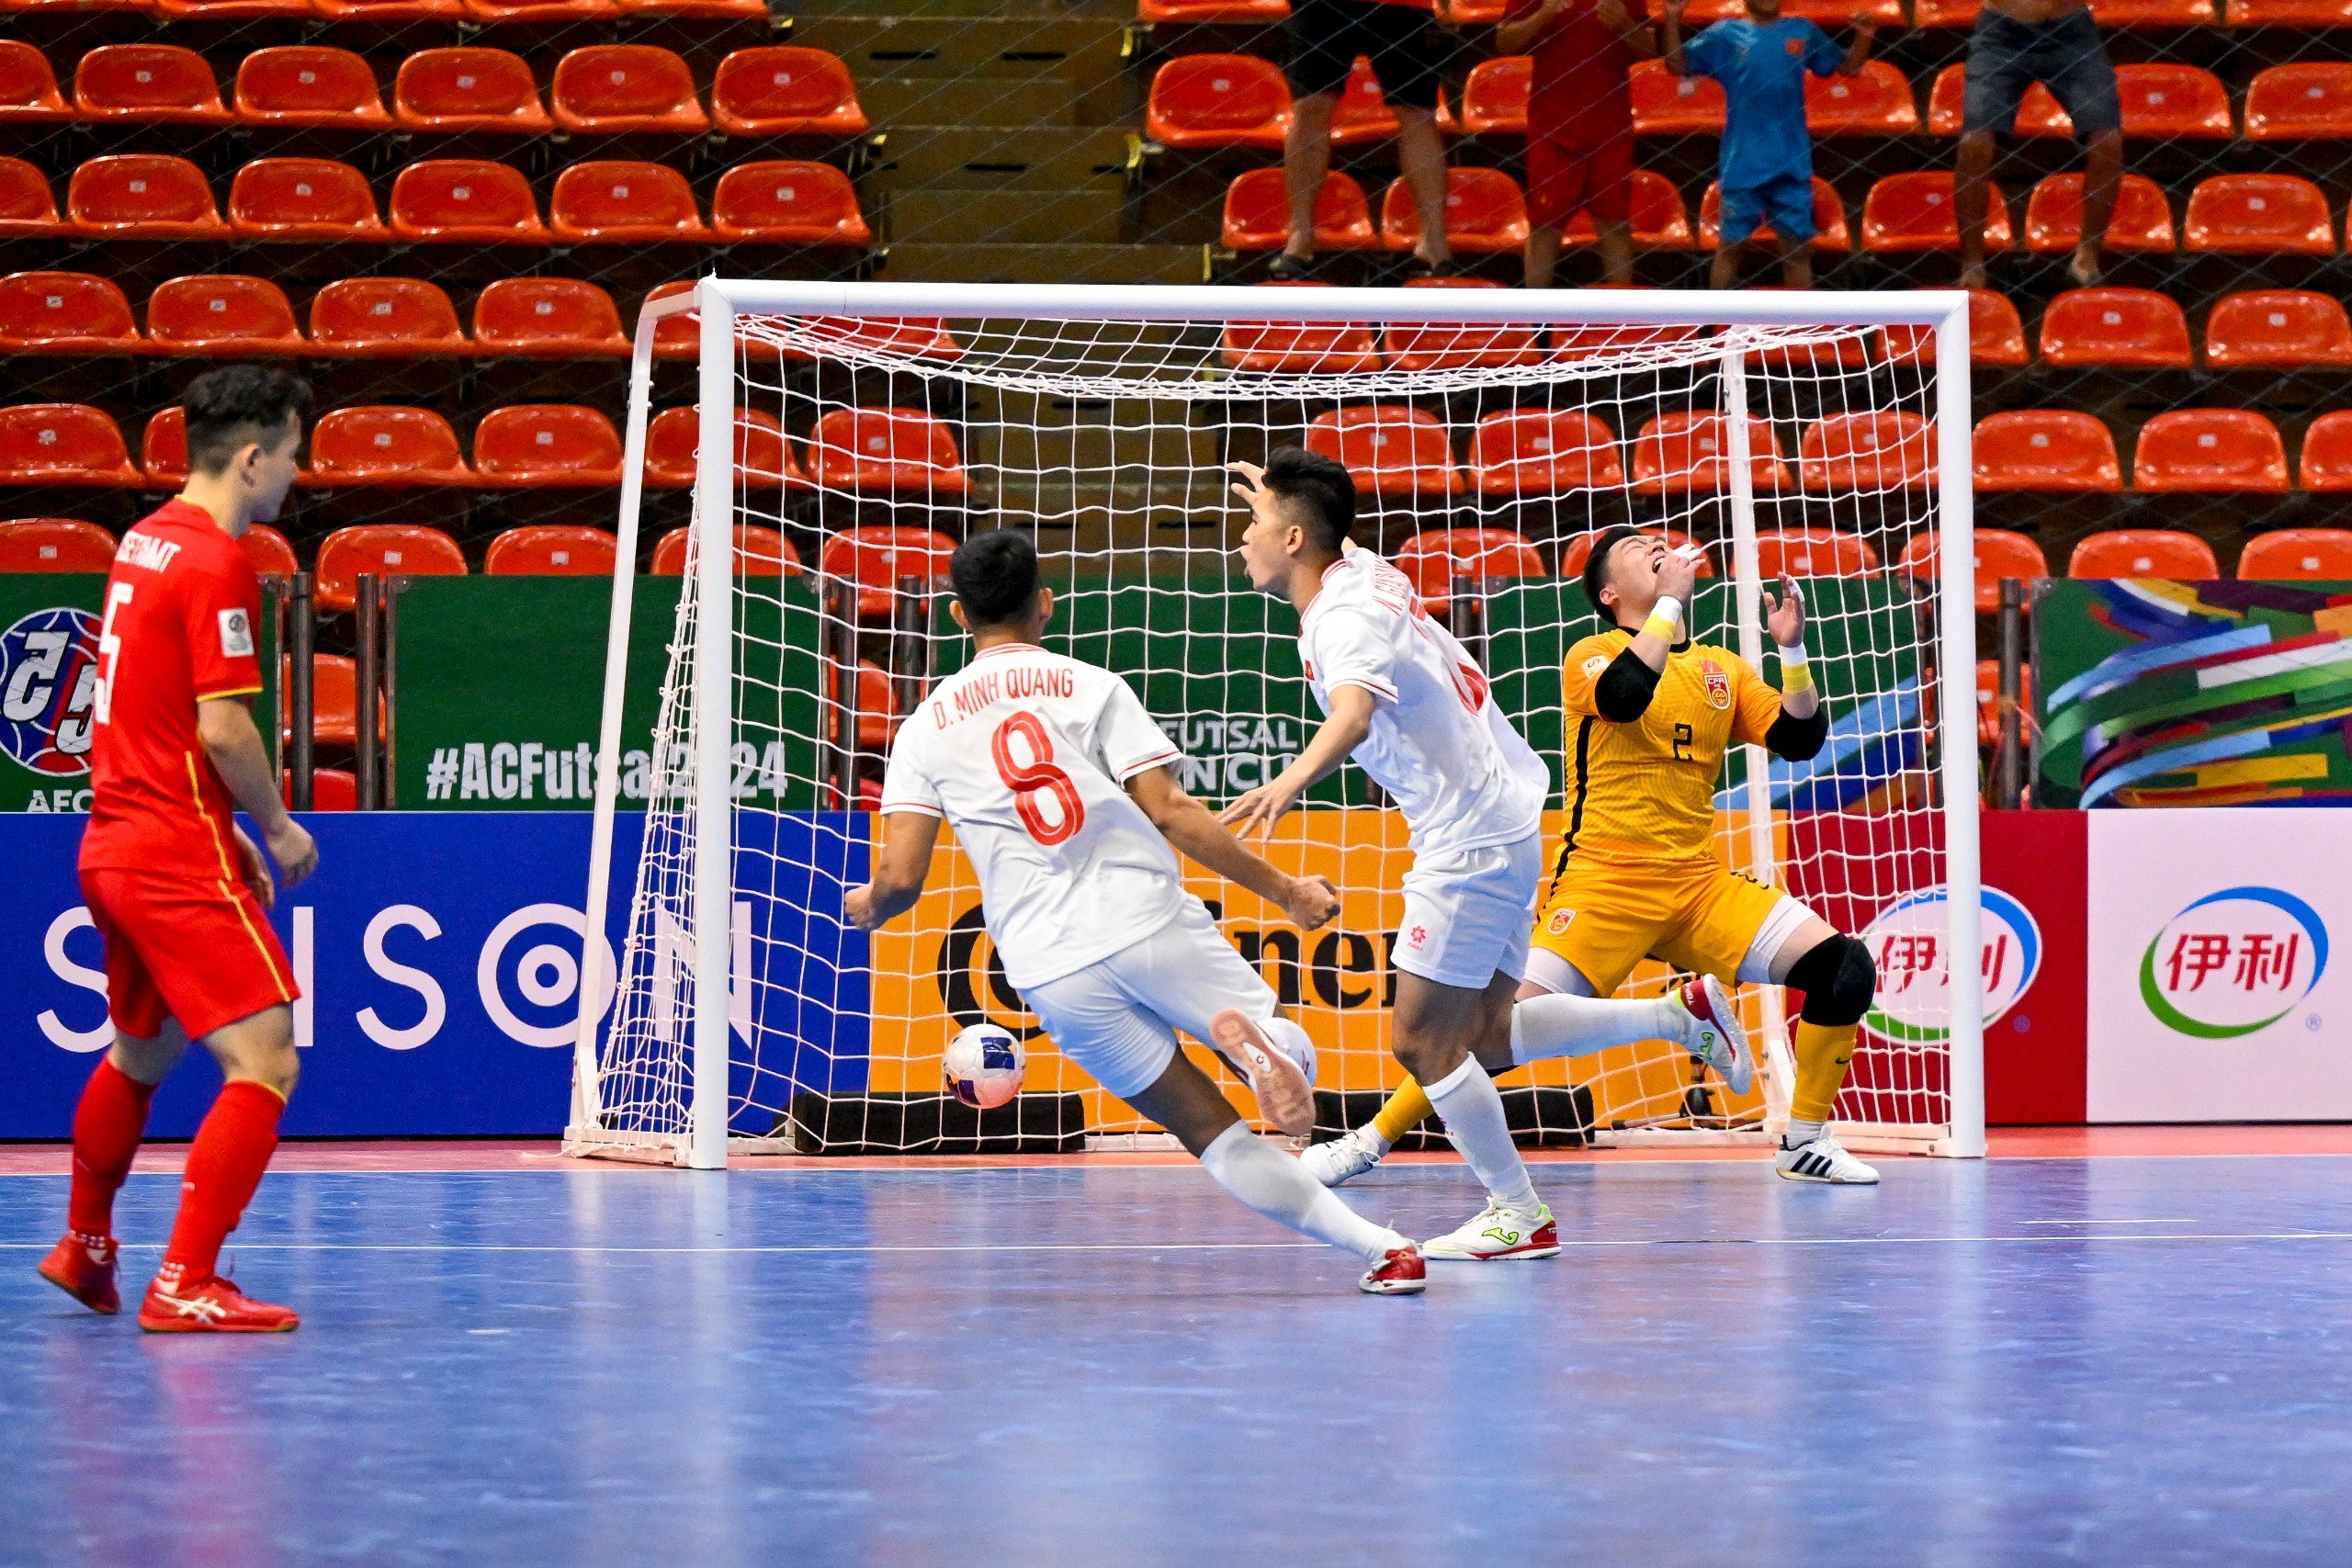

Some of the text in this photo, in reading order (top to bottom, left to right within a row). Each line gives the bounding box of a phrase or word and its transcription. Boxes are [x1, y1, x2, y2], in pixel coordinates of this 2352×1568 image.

[95, 581, 135, 726] 5
[955, 671, 1001, 721] MINH
[1006, 667, 1074, 699] QUANG
[1672, 722, 1693, 761] 2
[27, 789, 96, 812] AFC
[991, 710, 1085, 846] 8
[1226, 754, 1293, 791] CU
[37, 903, 752, 1053] SISON
[2165, 932, 2300, 992] 伊利
